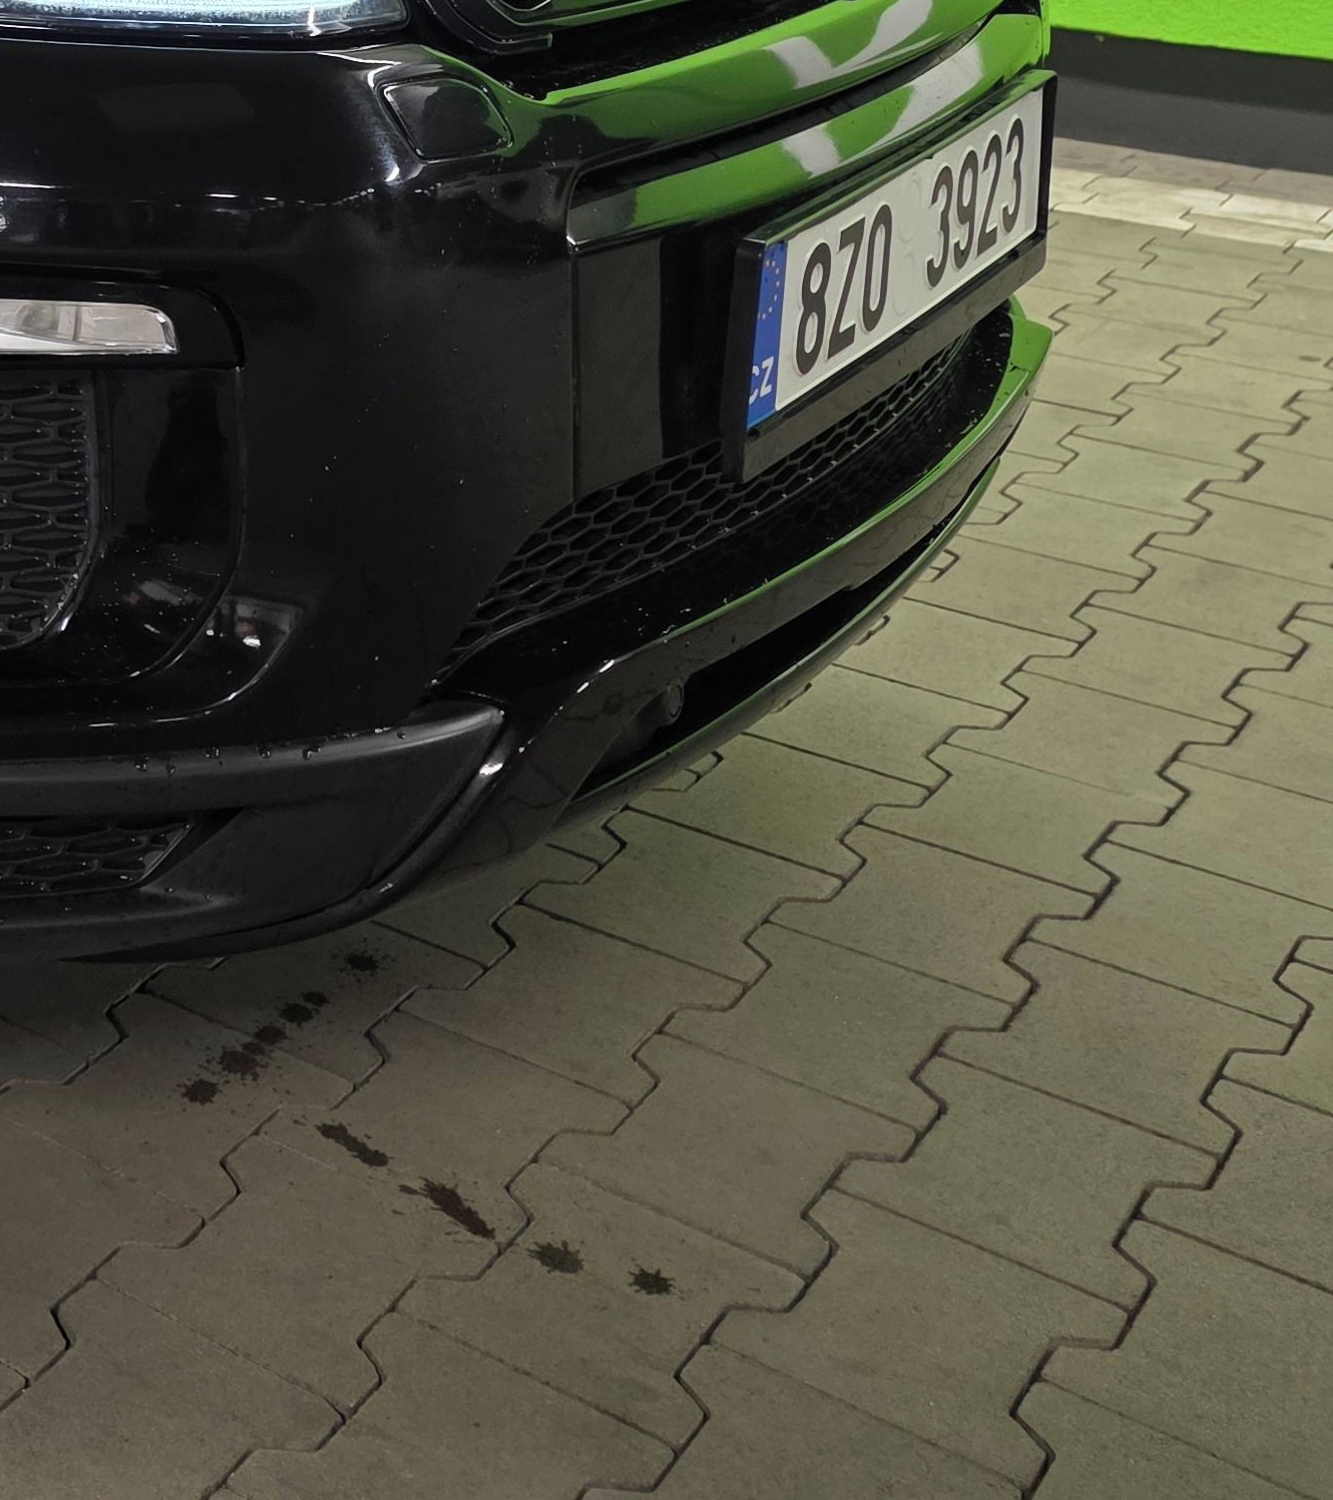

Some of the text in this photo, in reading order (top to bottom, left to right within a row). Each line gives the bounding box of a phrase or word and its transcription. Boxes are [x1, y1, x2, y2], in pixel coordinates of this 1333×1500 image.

[795, 117, 1025, 376] 8Z0 3923
[748, 355, 775, 405] CZ
